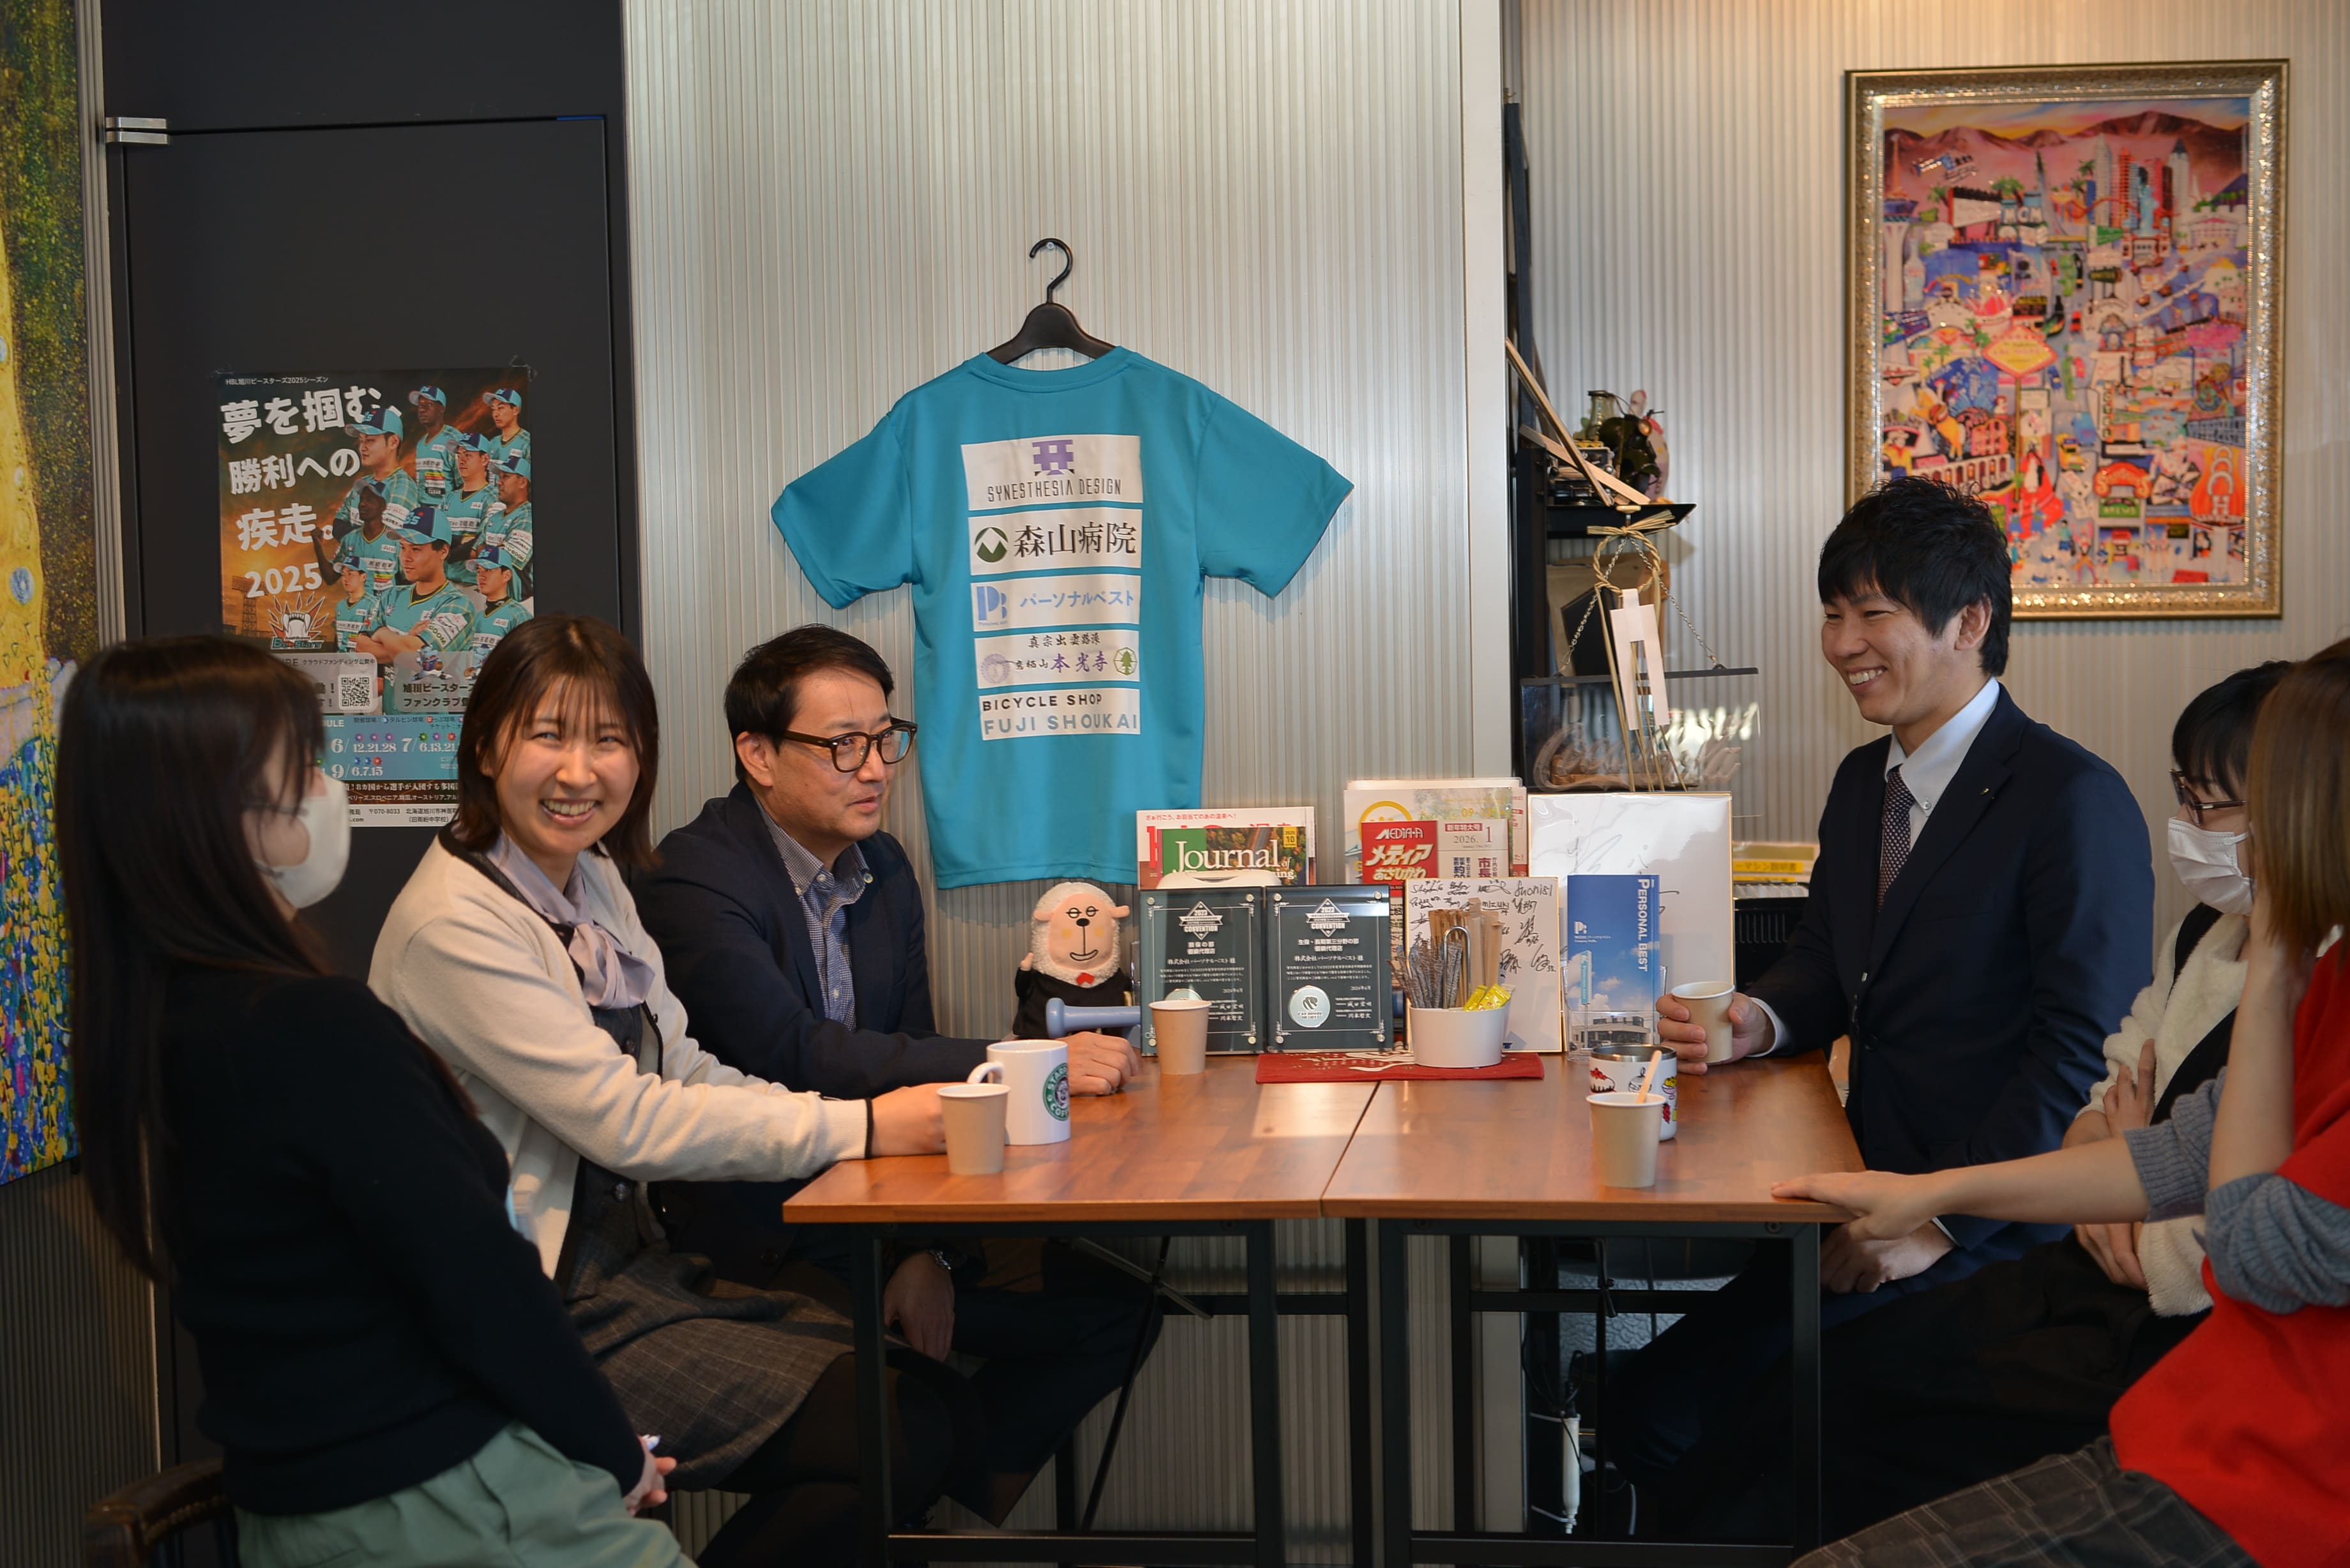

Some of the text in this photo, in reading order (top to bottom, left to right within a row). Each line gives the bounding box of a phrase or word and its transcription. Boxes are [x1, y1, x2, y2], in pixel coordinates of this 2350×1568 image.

[229, 448, 361, 495] 勝利への
[988, 478, 1122, 502] SYNESTHESIA DESIGN
[236, 502, 333, 551] 疾走。
[1014, 522, 1137, 559] 森山病院
[245, 562, 322, 598] 2025
[1020, 590, 1134, 608] パーソナルベスト
[983, 693, 1102, 711] BICYCLE SHOP
[984, 714, 1137, 734] FUJI SHOUKAI
[1485, 826, 1492, 843] 1
[1175, 840, 1282, 873] Journal
[1281, 857, 1292, 868] of
[1365, 843, 1434, 866] メディア
[1373, 867, 1427, 881] あさひかわ
[1638, 878, 1650, 972] PERSONAL BEST
